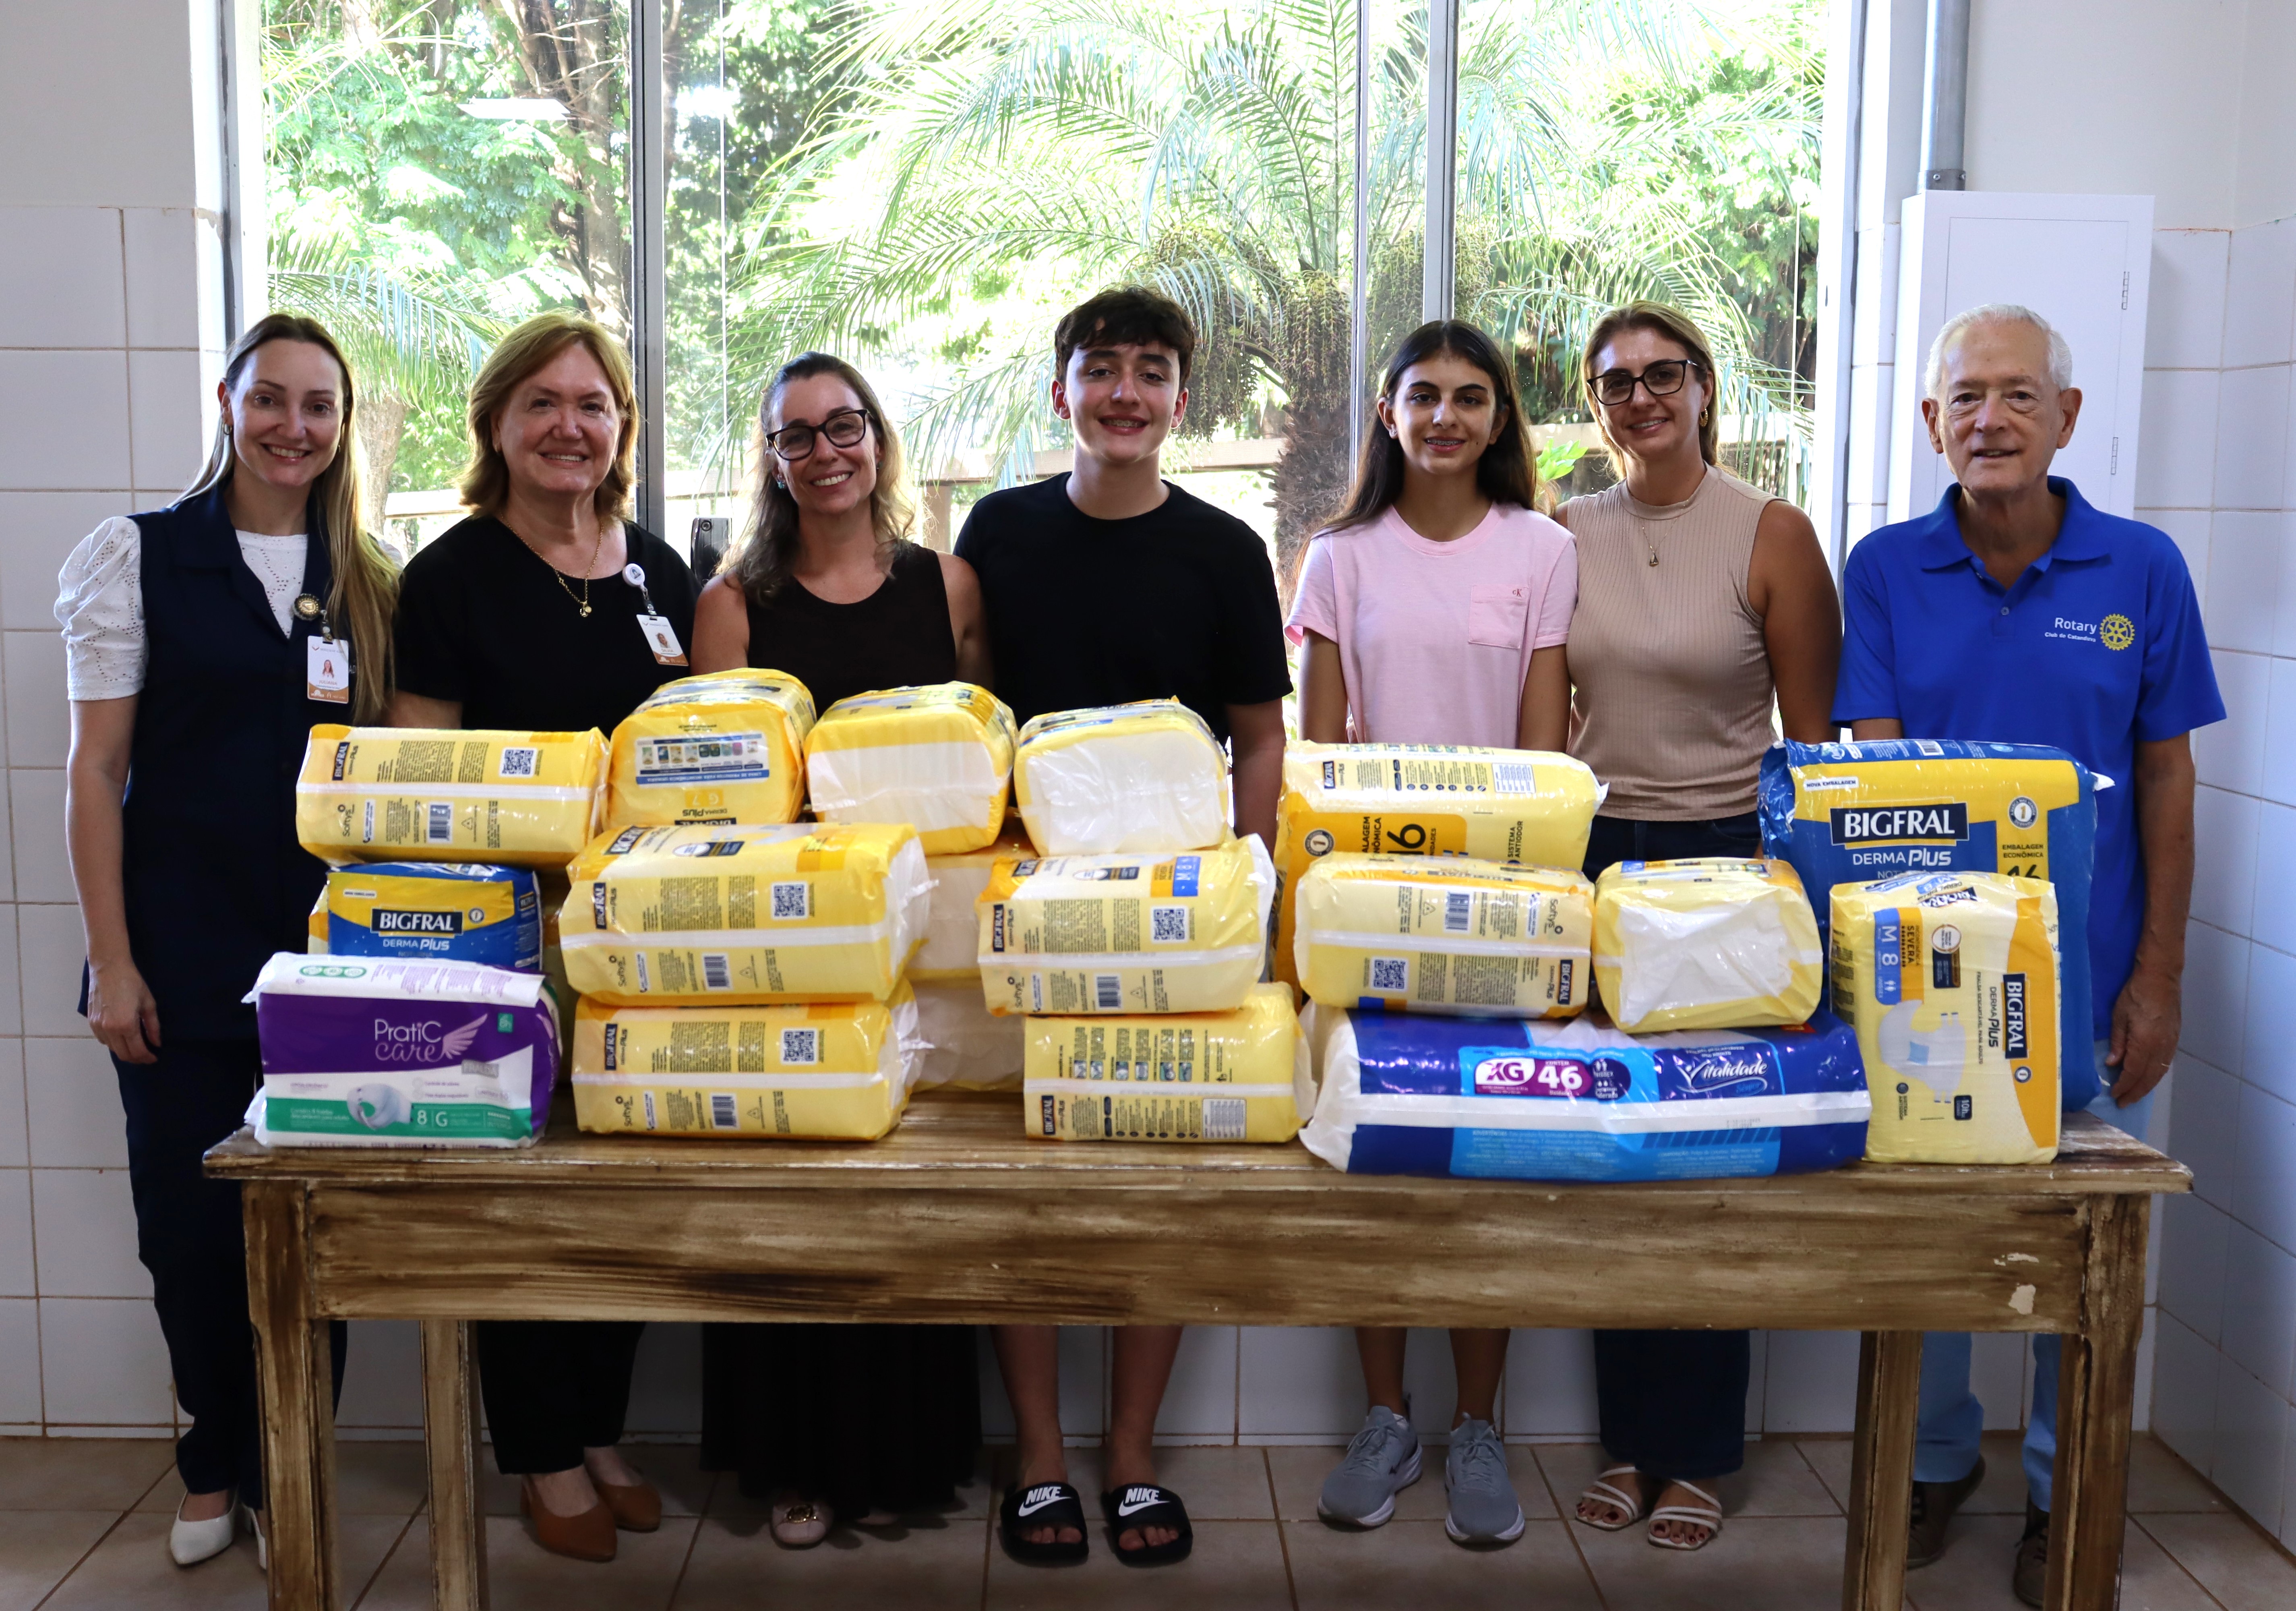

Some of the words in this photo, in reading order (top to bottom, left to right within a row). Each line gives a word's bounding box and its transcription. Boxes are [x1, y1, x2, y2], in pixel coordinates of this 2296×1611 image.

[2055, 617, 2097, 634] Rotary
[2067, 634, 2096, 642] Catanduva
[683, 809, 704, 818] Plus
[2021, 806, 2026, 819] 1
[1844, 809, 1955, 838] BIGFRAL
[1507, 826, 1516, 858] SISTEMA
[1514, 820, 1523, 858] ANTIODOR
[1853, 851, 1906, 866] DERMA
[1908, 848, 1952, 867] Plus
[380, 912, 454, 931] BIGFRAL
[1881, 926, 1897, 942] M
[383, 939, 418, 948] DERMA
[420, 938, 450, 951] Plus
[1882, 953, 1899, 966] 8
[1559, 963, 1571, 1002] BIGFRAL
[2006, 982, 2024, 1052] BIGFRAL
[374, 1018, 442, 1043] PratiC
[1988, 1018, 2000, 1048] Plus
[375, 1042, 444, 1062] care
[1486, 1062, 1525, 1082] XG
[1537, 1065, 1583, 1090] 46
[1676, 1058, 1768, 1087] Vitalidade
[417, 1110, 428, 1125] 8
[435, 1111, 449, 1127] G
[1025, 1486, 1061, 1505] NIKE
[1125, 1488, 1160, 1504] NIKE
